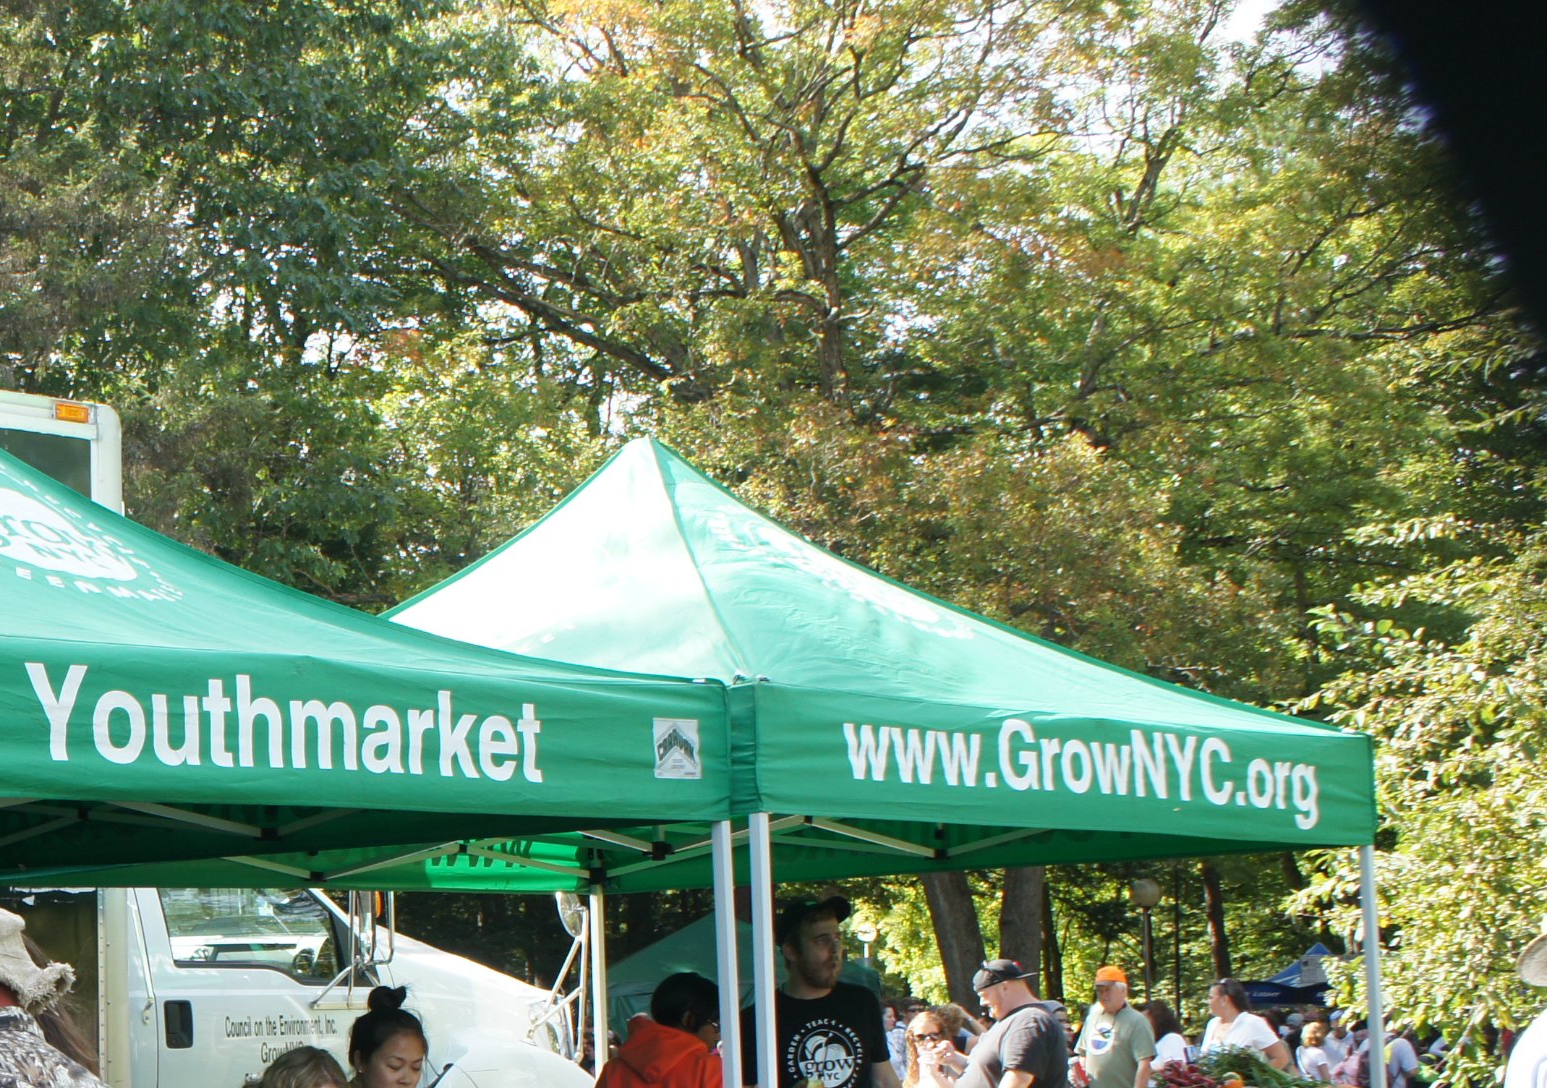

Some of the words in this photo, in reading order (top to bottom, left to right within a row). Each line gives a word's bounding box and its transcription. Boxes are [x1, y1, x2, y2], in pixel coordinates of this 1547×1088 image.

[24, 661, 544, 784] Youthmarket
[843, 717, 1320, 831] www.GrowNYC.org
[224, 1015, 252, 1038] Council
[253, 1021, 263, 1037] on
[265, 1016, 277, 1036] the
